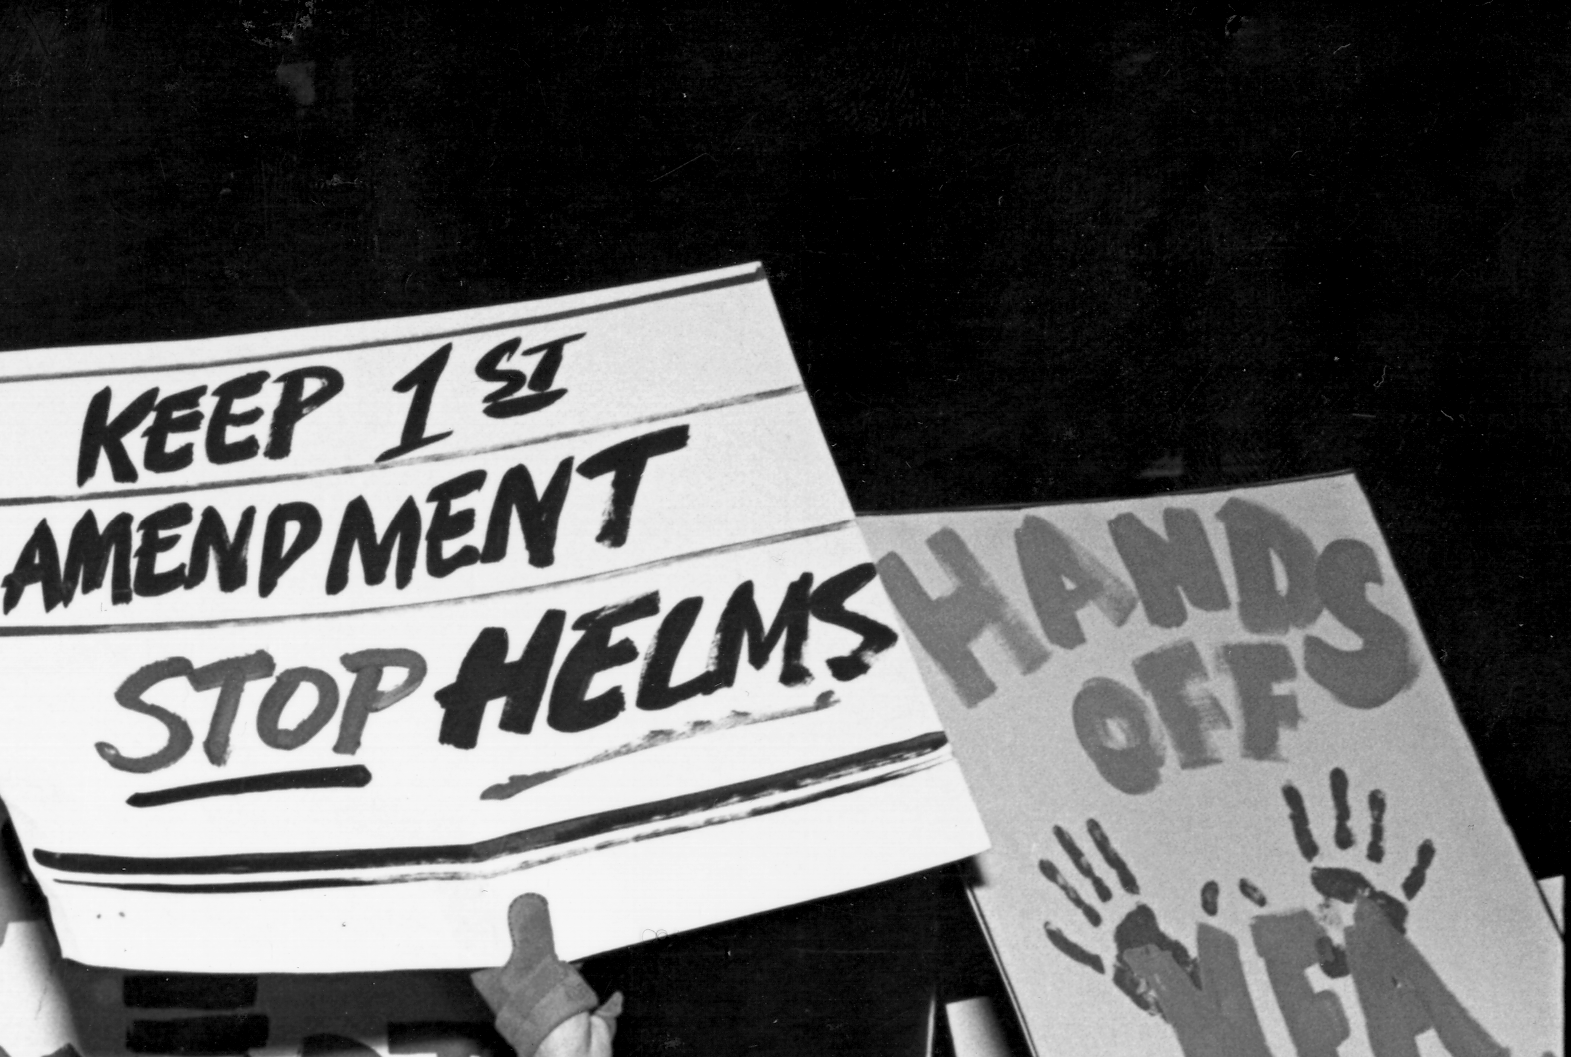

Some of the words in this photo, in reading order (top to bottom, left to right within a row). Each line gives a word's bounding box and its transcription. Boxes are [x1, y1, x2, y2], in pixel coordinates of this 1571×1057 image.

[0, 424, 691, 615] AMENDMENT
[76, 365, 345, 488] KEEP
[92, 646, 428, 774] STOP
[433, 562, 900, 750] HELMS
[876, 496, 1420, 710] HANDS
[1071, 638, 1306, 796] OFF
